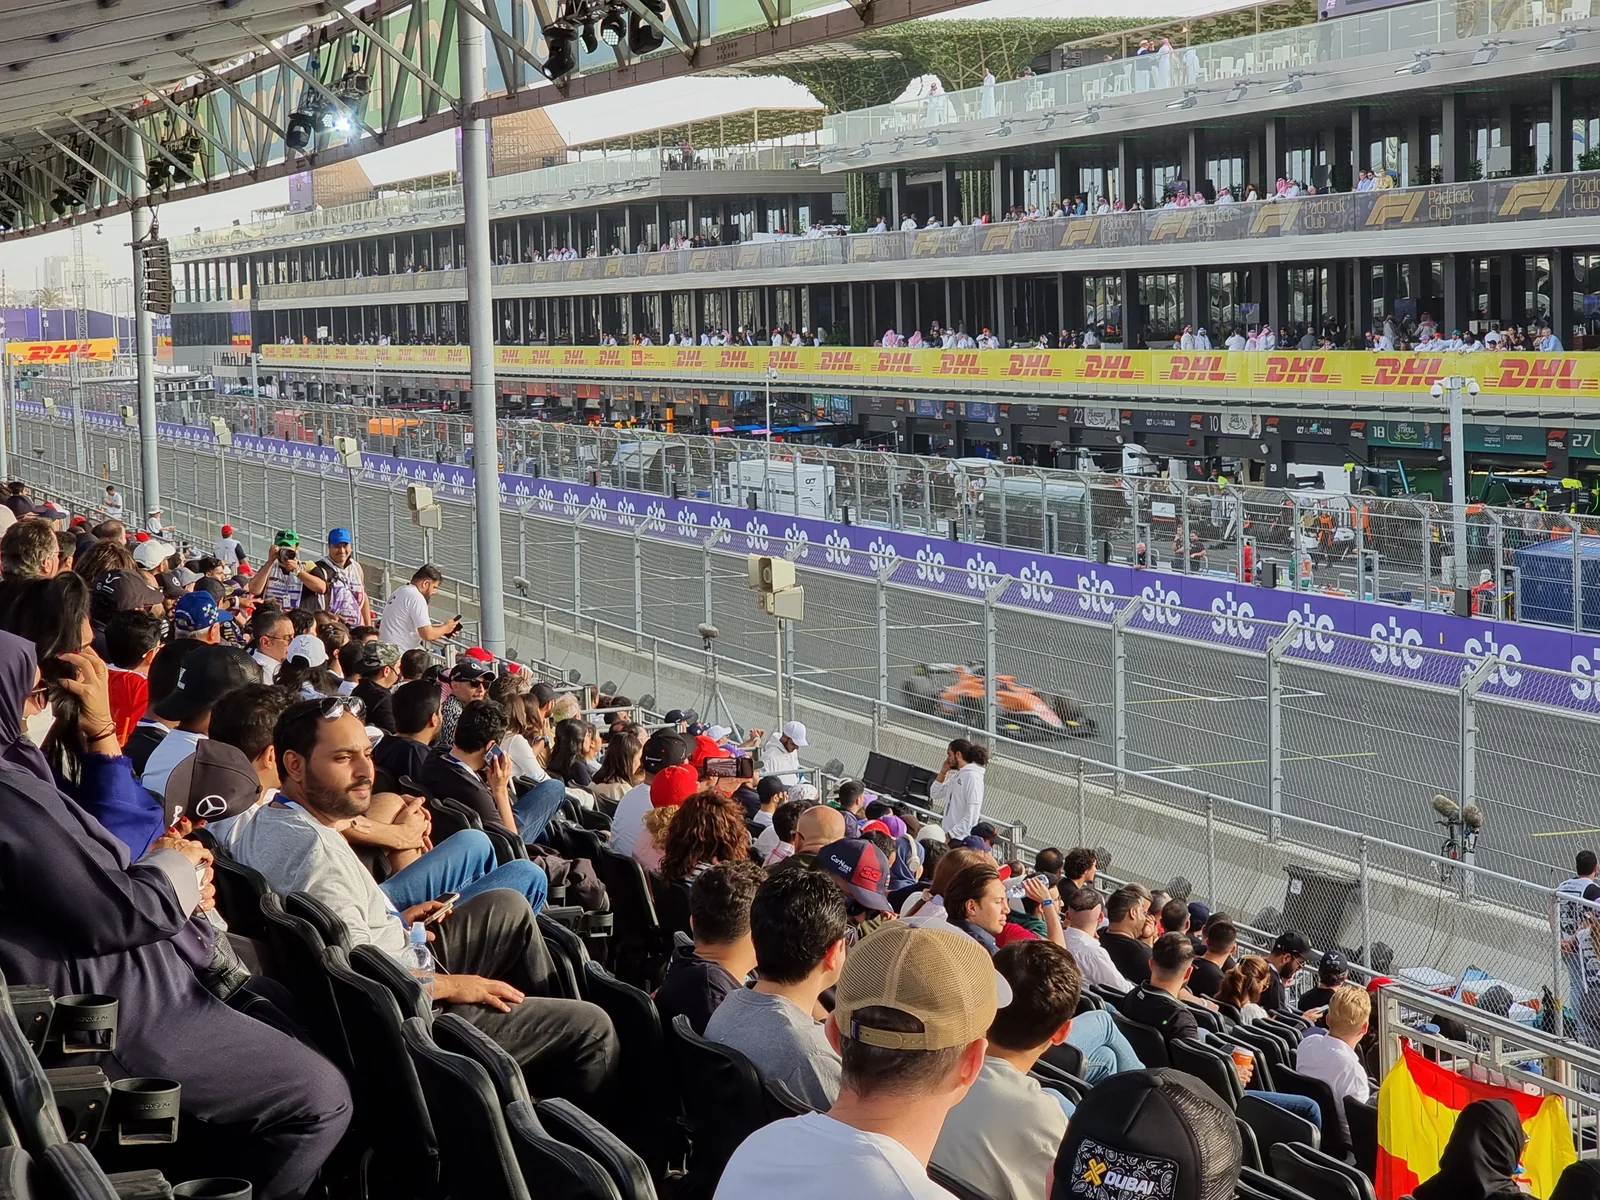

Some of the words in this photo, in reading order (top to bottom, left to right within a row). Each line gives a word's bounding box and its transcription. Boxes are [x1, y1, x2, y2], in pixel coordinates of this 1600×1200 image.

[1304, 198, 1345, 215] Paddock
[1428, 187, 1475, 204] Paddock
[1572, 193, 1600, 210] Club
[1304, 214, 1326, 230] Club
[1428, 204, 1452, 221] Club
[27, 343, 97, 361] DHL
[677, 350, 703, 367] DHL
[720, 350, 749, 368] DHL
[769, 351, 800, 369] DHL
[820, 352, 855, 370] DHL
[877, 352, 916, 372] DHL
[940, 354, 980, 374] DHL
[1008, 354, 1057, 377] DHL
[1084, 355, 1134, 378] DHL
[1170, 356, 1227, 381] DHL
[1265, 357, 1332, 384] DHL
[1374, 358, 1444, 385] DHL
[1498, 358, 1582, 388] DHL
[1073, 408, 1084, 424] 22
[1209, 416, 1218, 432] 10
[1372, 426, 1385, 438] 18
[1572, 434, 1592, 448] 27
[452, 464, 465, 496] stc
[515, 480, 530, 506] stc
[538, 484, 554, 512] stc
[563, 488, 580, 516] stc
[590, 492, 608, 522] stc
[617, 496, 636, 526] stc
[646, 500, 666, 533] stc
[678, 506, 698, 538] stc
[710, 510, 732, 545] stc
[746, 516, 770, 551] stc
[784, 522, 809, 558] stc
[824, 529, 851, 566] stc
[868, 536, 896, 572] stc
[916, 543, 946, 584] stc
[966, 552, 998, 592] stc
[1020, 560, 1054, 604] stc
[1078, 570, 1116, 615] stc
[1141, 580, 1182, 626] stc
[1211, 591, 1255, 640] stc
[1287, 602, 1336, 654] stc
[1370, 616, 1424, 670] stc
[1464, 630, 1523, 688] stc
[830, 854, 853, 872] CarNext
[1104, 1171, 1155, 1195] DUBAI
